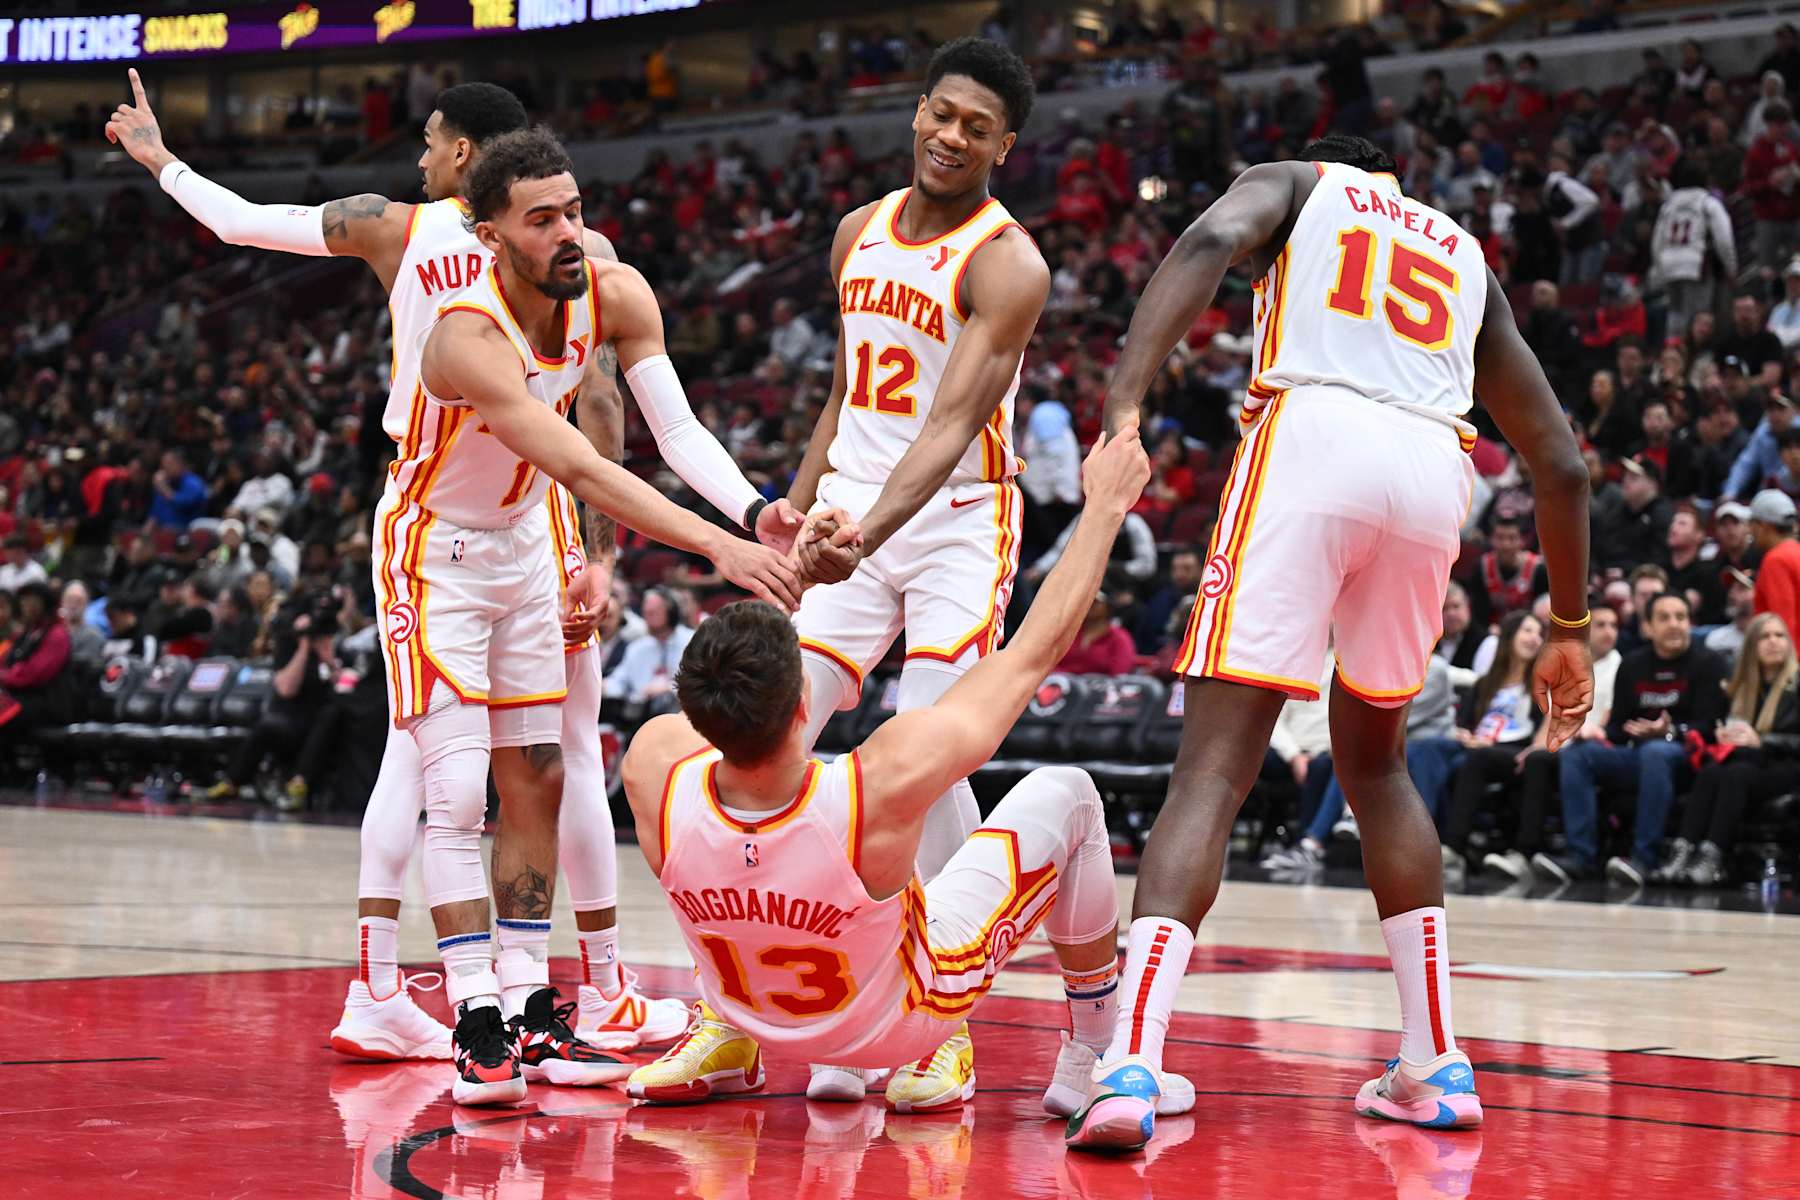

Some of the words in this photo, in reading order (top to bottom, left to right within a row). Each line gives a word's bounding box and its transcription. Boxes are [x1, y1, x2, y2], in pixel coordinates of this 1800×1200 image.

[18, 14, 141, 62] INTENSE
[143, 13, 228, 53] SNACKS
[1345, 186, 1459, 256] CAPELA
[416, 253, 497, 296] MUR
[1325, 225, 1462, 352] 15
[840, 276, 947, 346] ATLANTA
[848, 340, 920, 418] 12
[499, 460, 539, 509] 1
[670, 887, 862, 939] BOGDANOVIĆ
[699, 934, 859, 1018] 13
